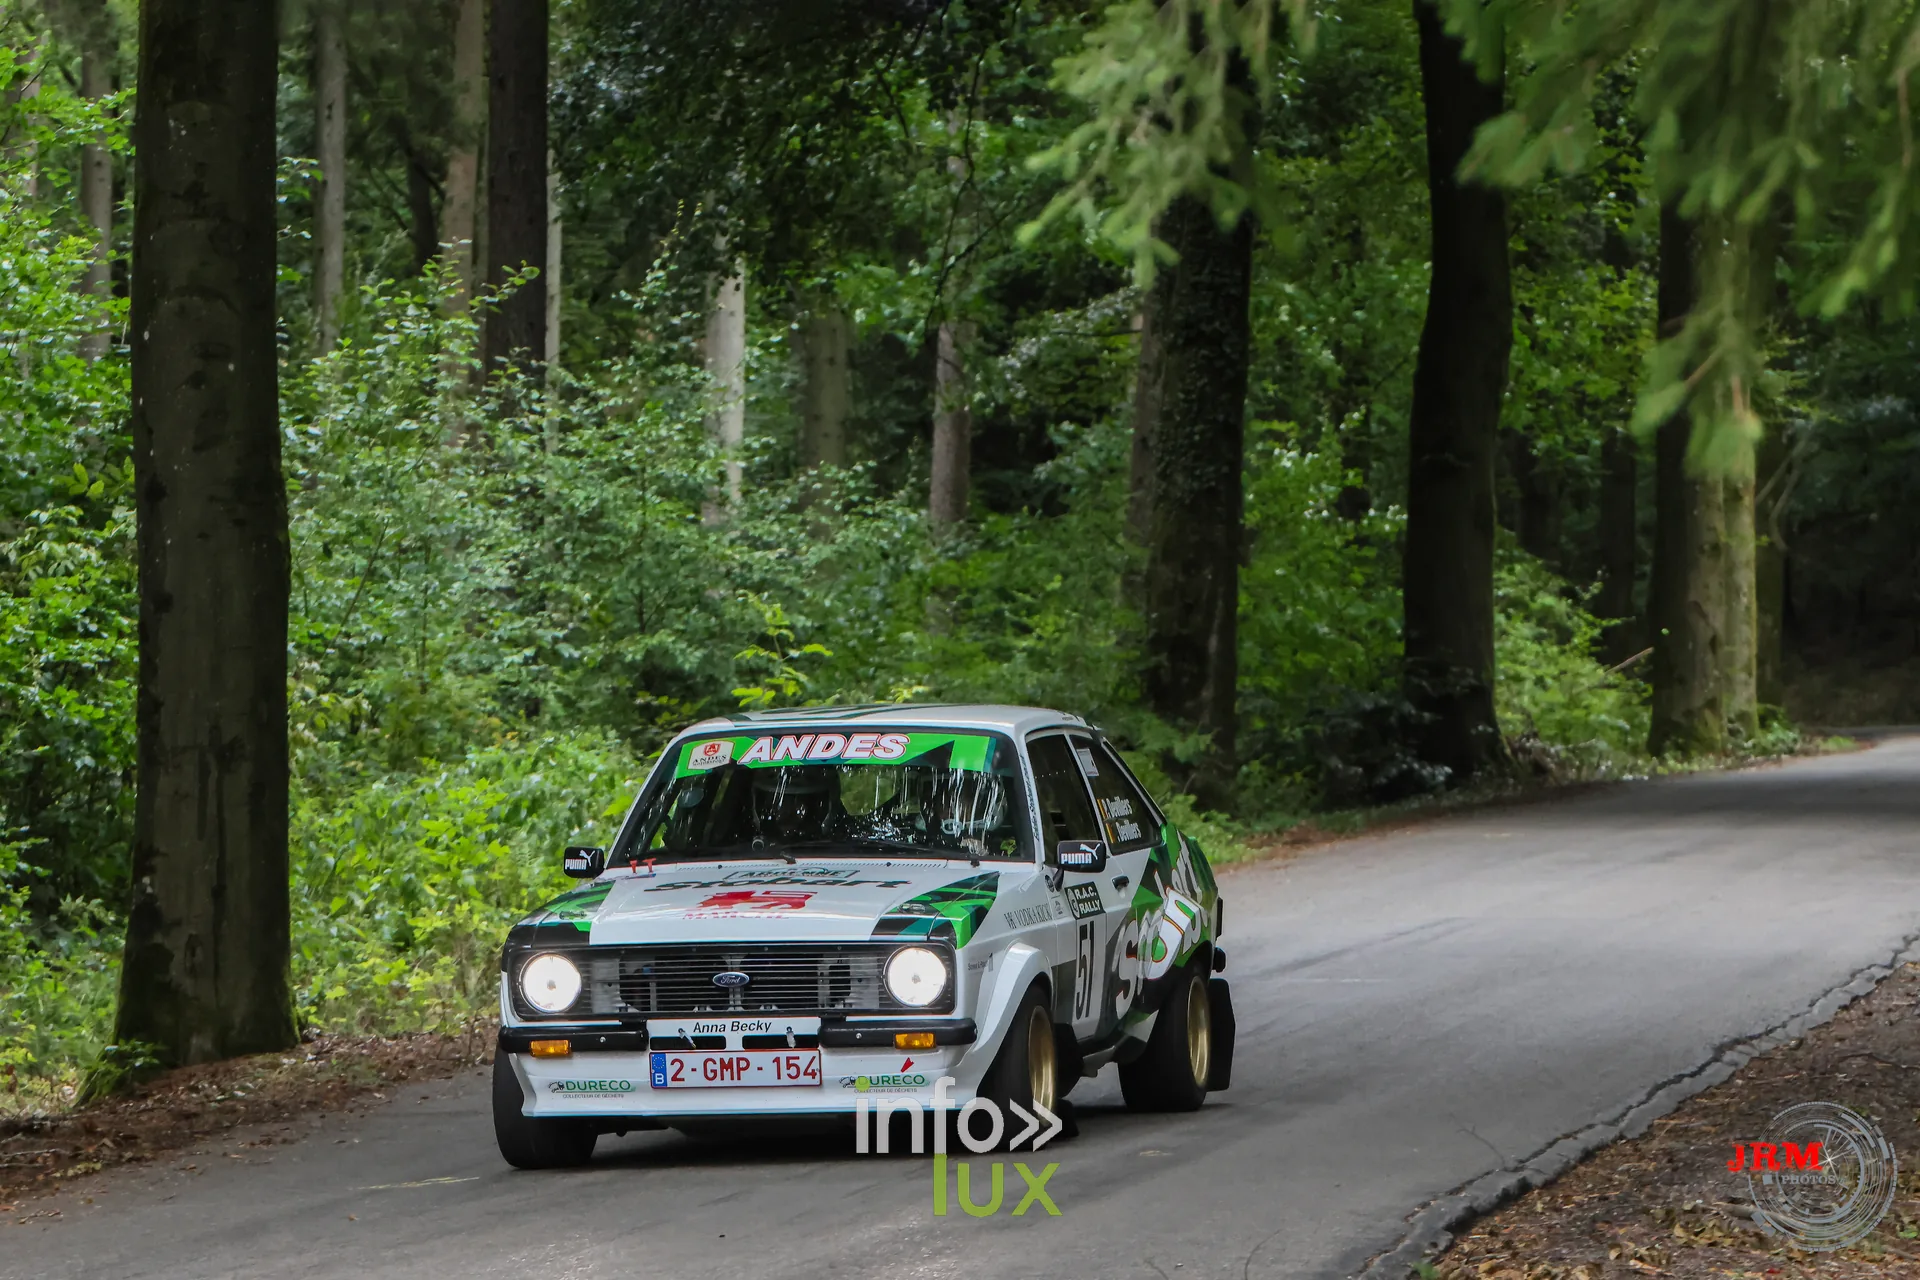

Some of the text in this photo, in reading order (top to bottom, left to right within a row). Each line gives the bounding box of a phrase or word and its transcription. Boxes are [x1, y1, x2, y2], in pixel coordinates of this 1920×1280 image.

[737, 732, 911, 764] ANDES
[564, 858, 587, 870] PUMA
[1060, 852, 1092, 865] PUMA
[1074, 885, 1097, 899] R.A.C.
[1079, 899, 1101, 914] RALLY
[1075, 920, 1095, 1021] 51
[720, 975, 741, 984] Ford
[693, 1019, 772, 1033] Anna Becky
[670, 1055, 818, 1082] 2-GMP-154
[565, 1080, 631, 1091] DURECO
[655, 1073, 665, 1085] B
